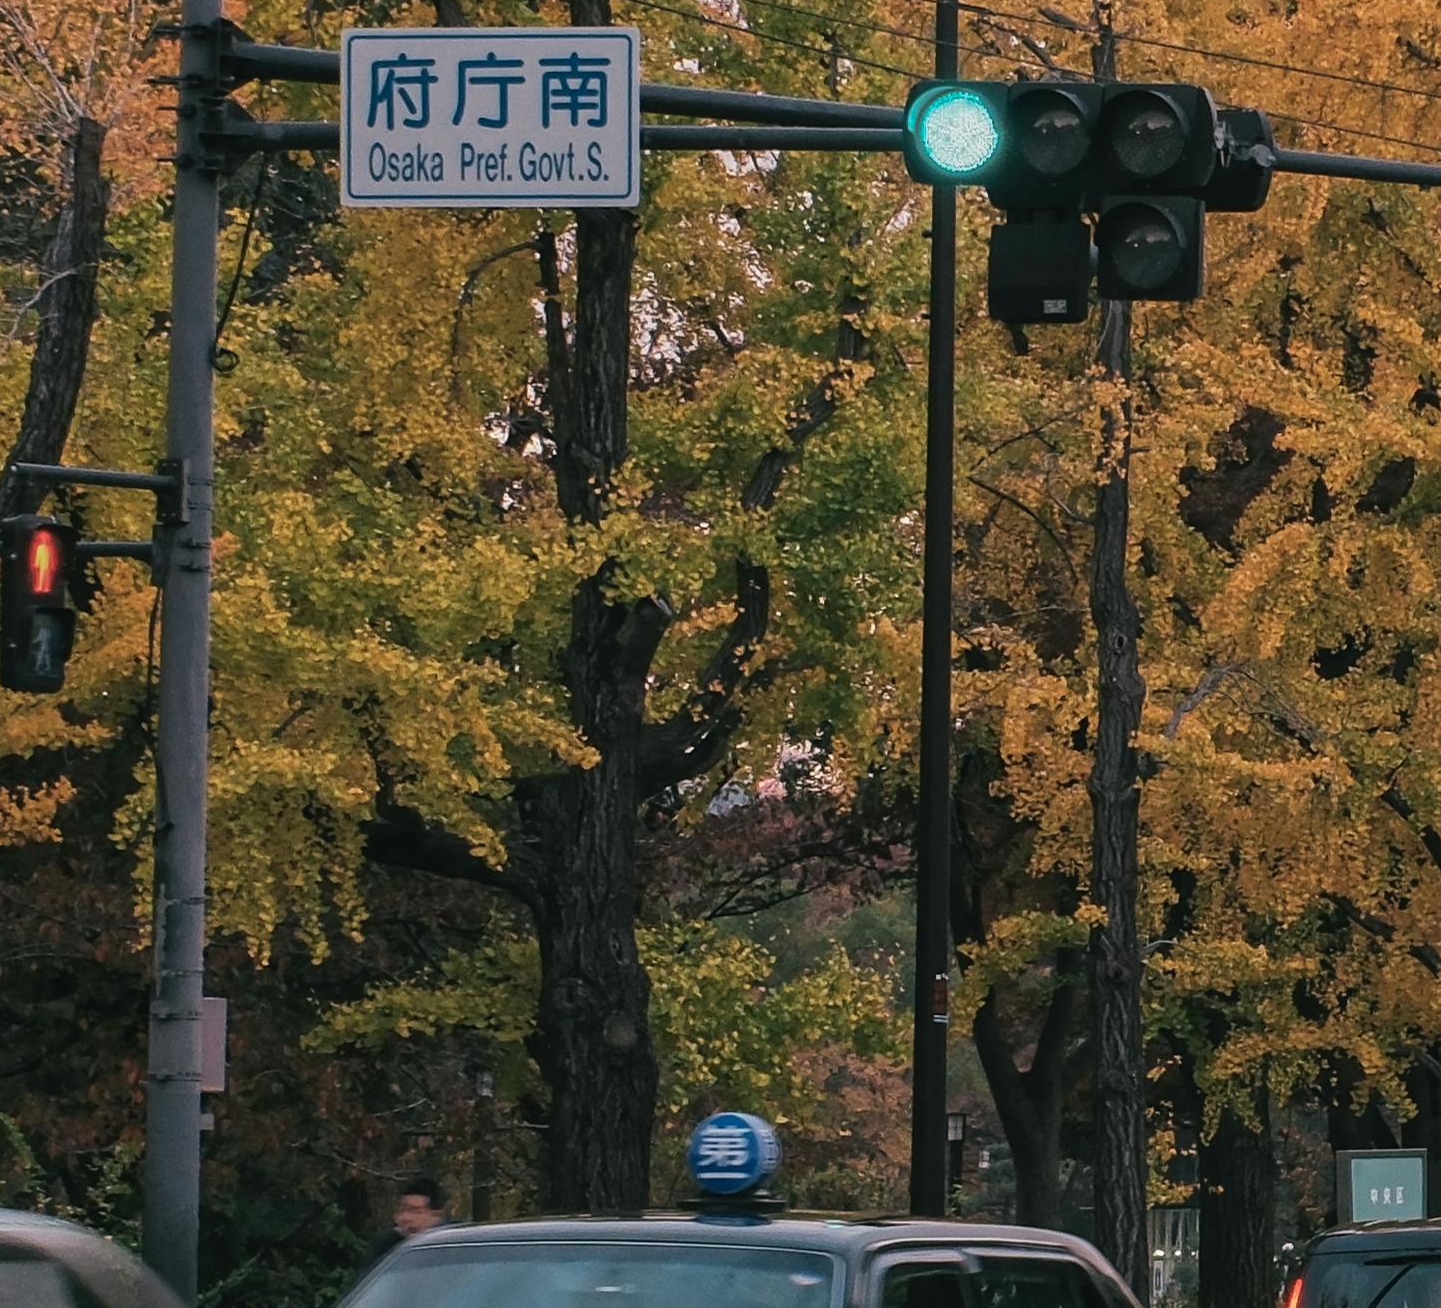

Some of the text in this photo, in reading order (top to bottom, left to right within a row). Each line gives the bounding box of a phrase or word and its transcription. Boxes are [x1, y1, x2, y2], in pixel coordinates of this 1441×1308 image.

[367, 52, 612, 131] 府庁南
[369, 142, 443, 183] Osaka
[1370, 1186, 1404, 1205] 中央区
